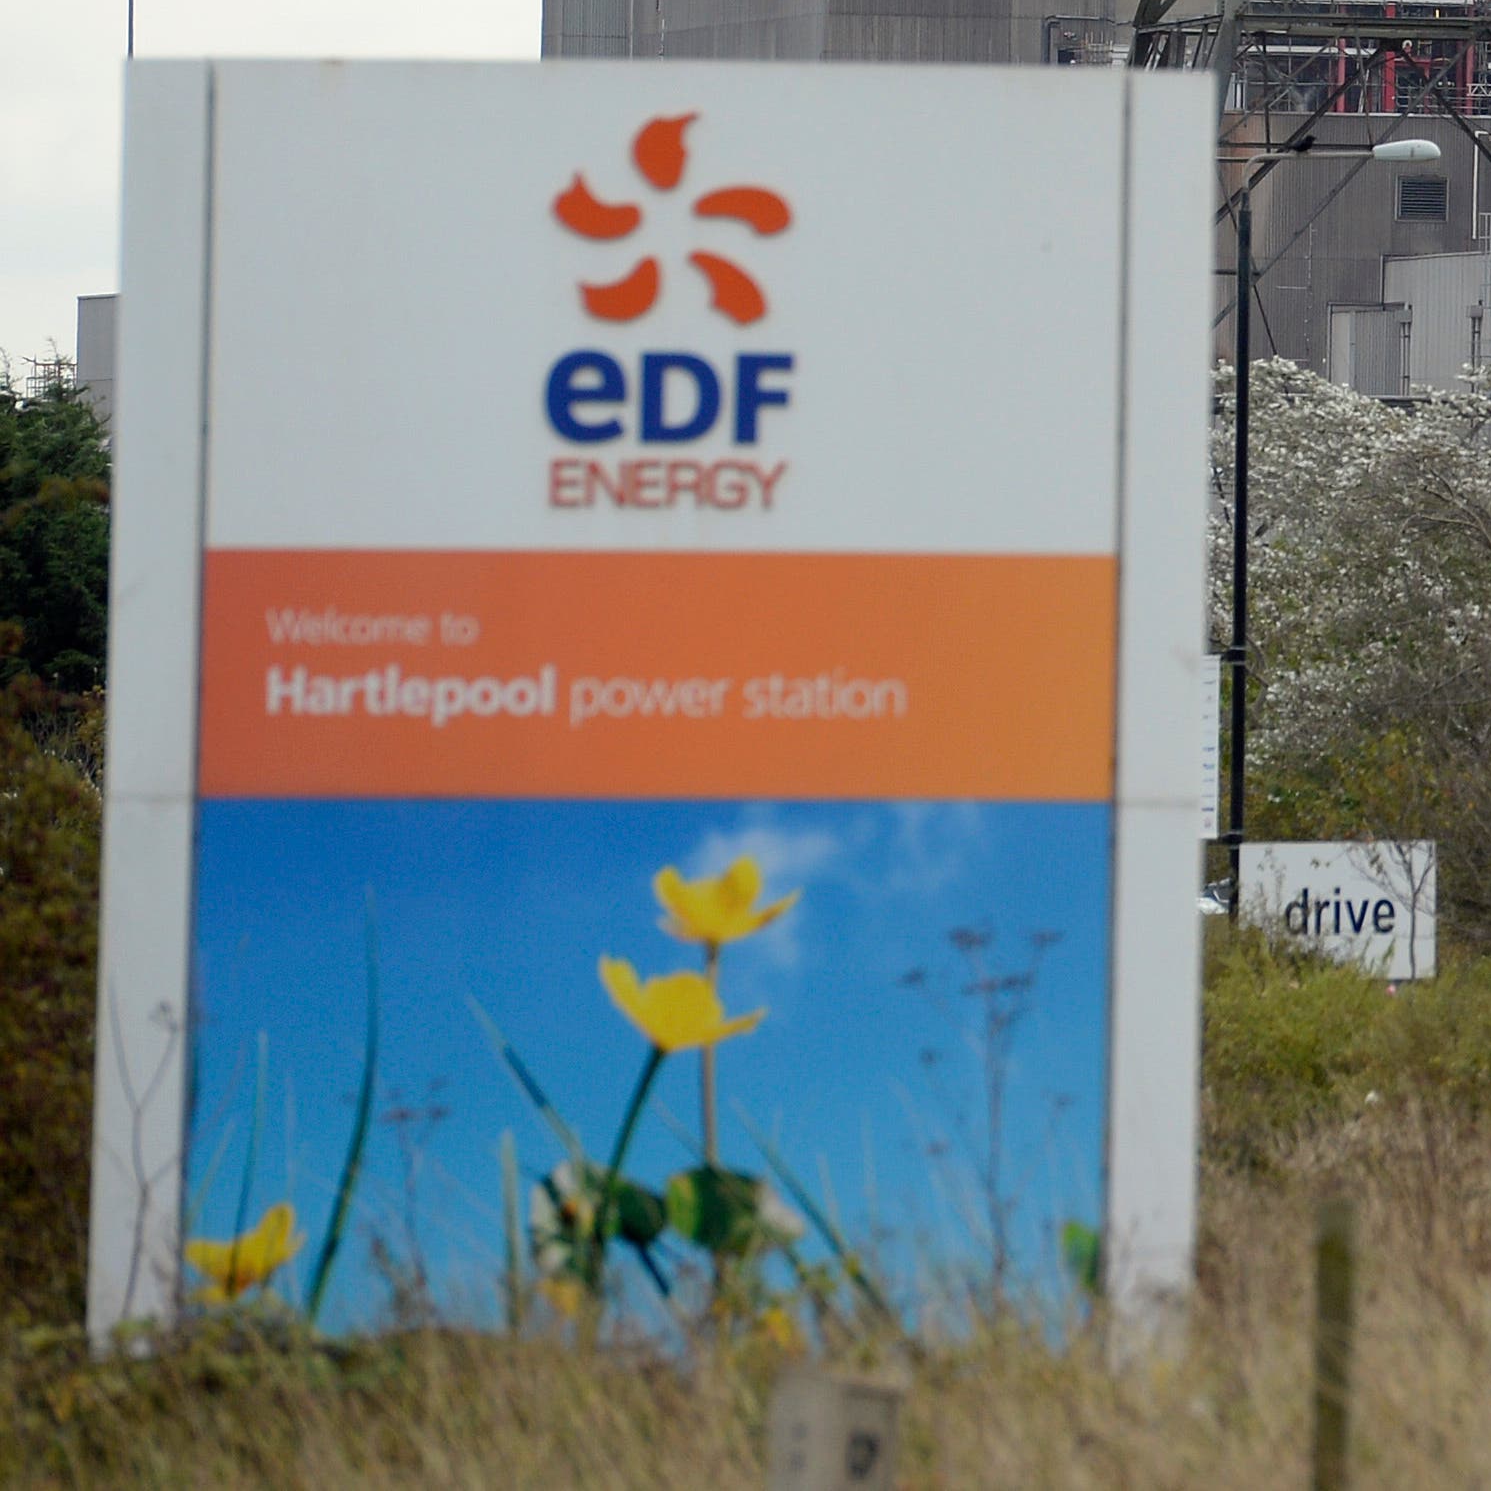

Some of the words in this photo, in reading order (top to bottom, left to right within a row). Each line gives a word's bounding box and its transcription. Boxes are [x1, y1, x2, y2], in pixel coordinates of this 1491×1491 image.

[549, 457, 788, 509] ENERGY
[264, 606, 431, 645] Welcome
[440, 611, 480, 645] to
[265, 663, 558, 728] Hartlepool
[568, 674, 730, 730] power
[741, 666, 908, 719] station
[1285, 887, 1395, 936] drive
